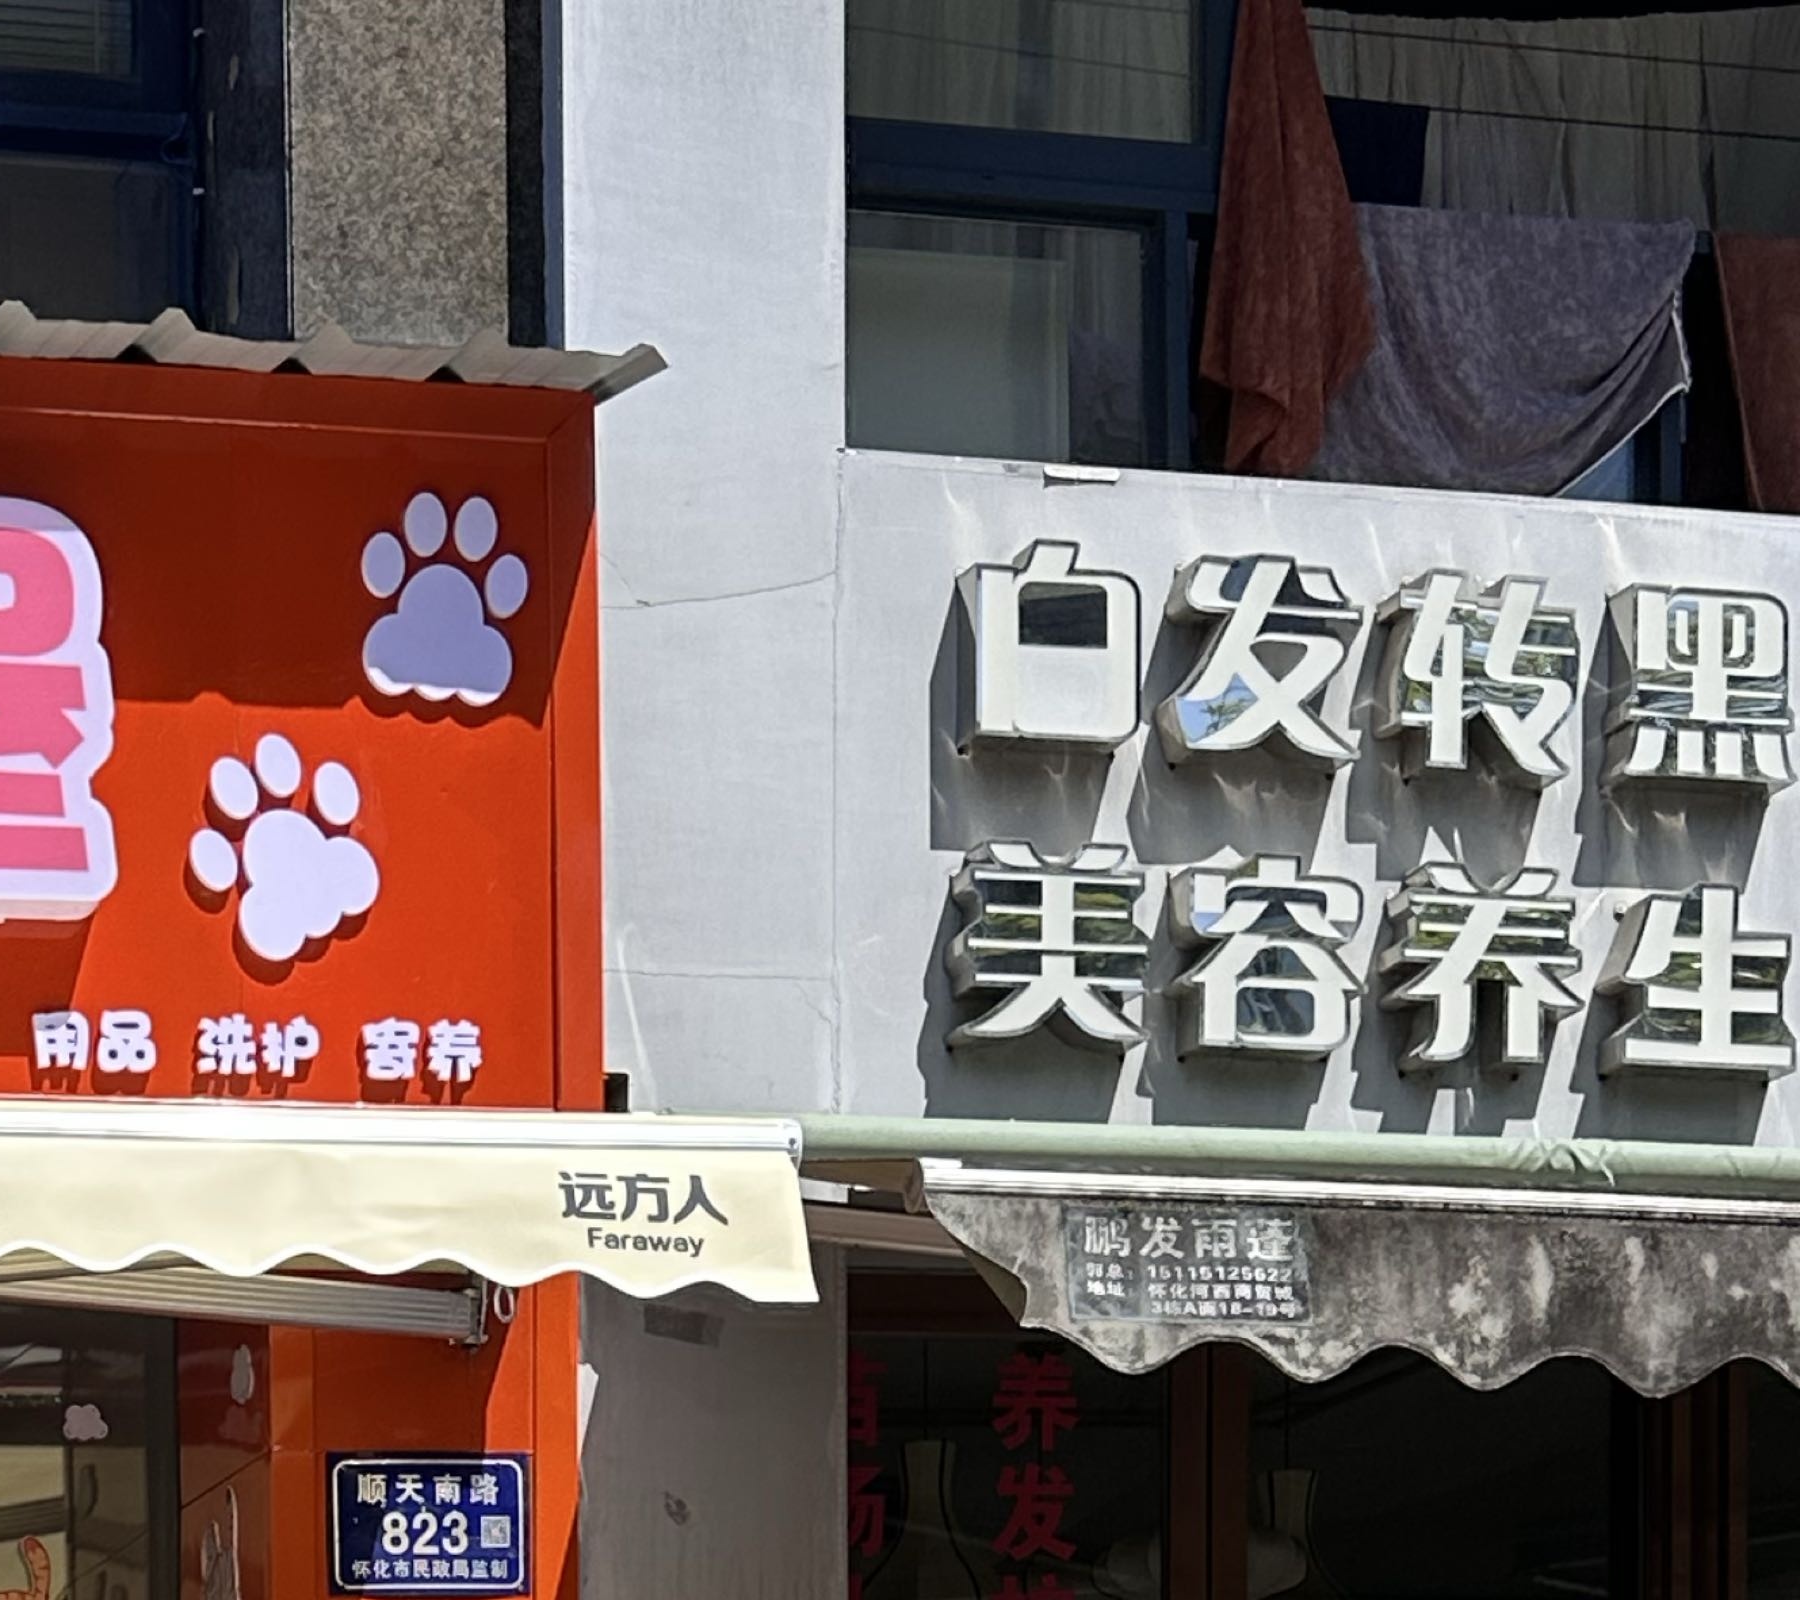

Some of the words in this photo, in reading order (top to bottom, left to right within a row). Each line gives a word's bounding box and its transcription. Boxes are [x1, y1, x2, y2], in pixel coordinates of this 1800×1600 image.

[957, 538, 1796, 798] 白发转黑
[947, 841, 1797, 1079] 美容养生
[33, 1008, 158, 1076] 用品
[197, 1011, 321, 1079] 洗护
[361, 1016, 484, 1086] 寄养
[559, 1171, 729, 1228] 远方人
[586, 1228, 706, 1259] Faraway
[356, 1473, 500, 1507] 顺天南路
[381, 1510, 470, 1556] 823
[351, 1559, 509, 1580] 怀化市民政局监制
